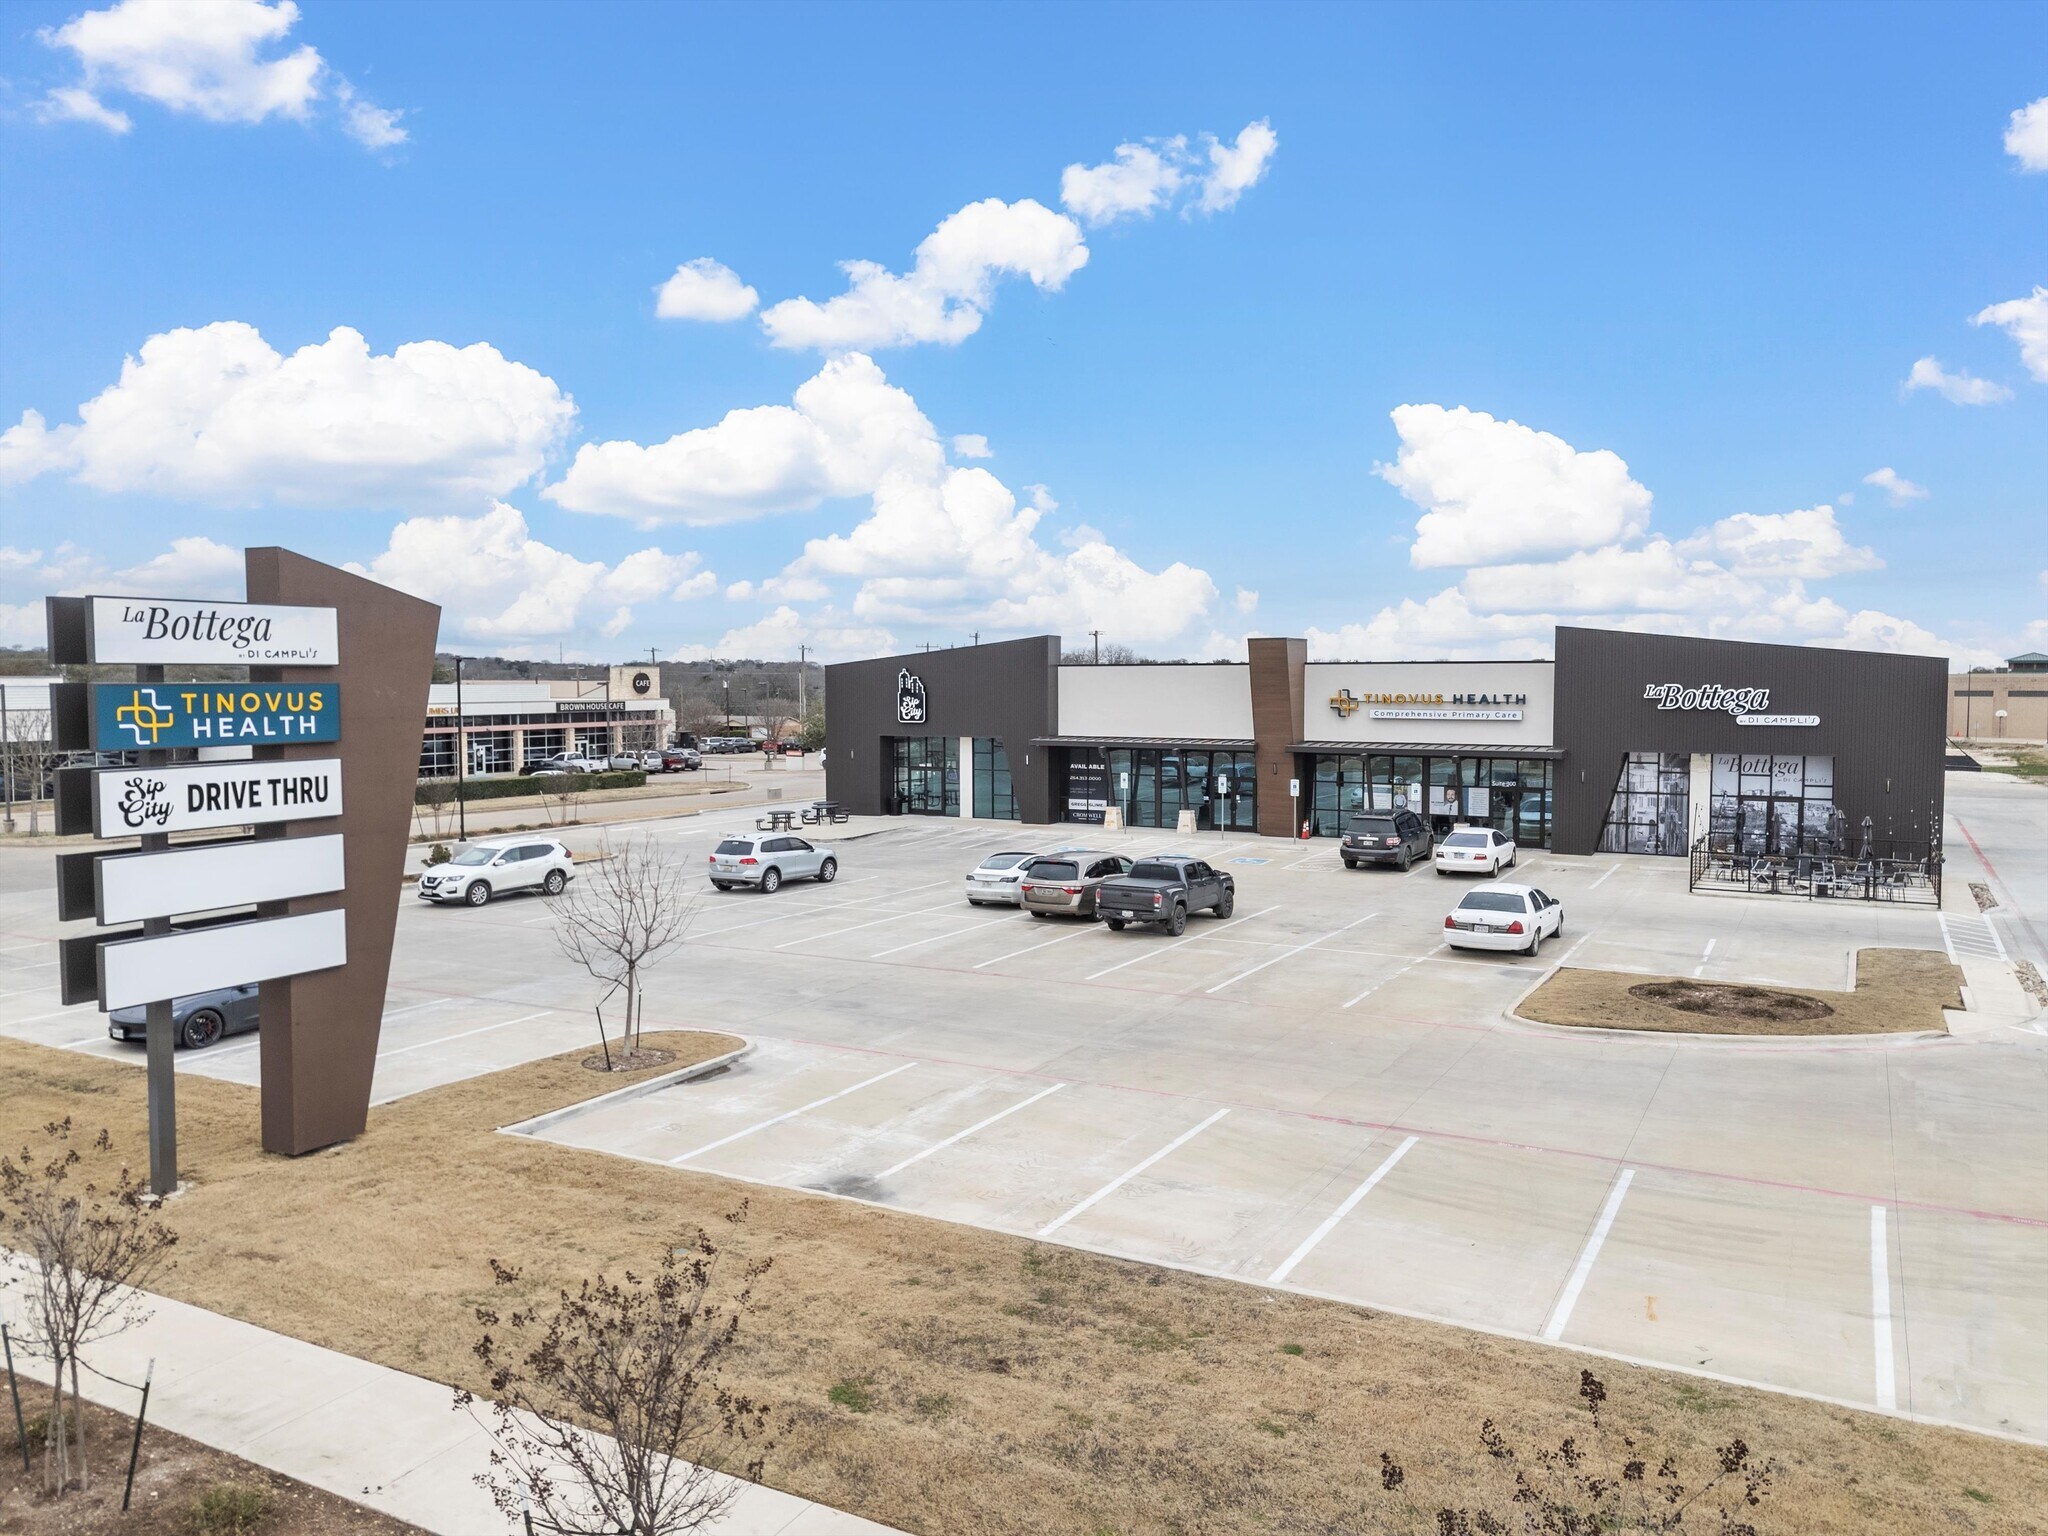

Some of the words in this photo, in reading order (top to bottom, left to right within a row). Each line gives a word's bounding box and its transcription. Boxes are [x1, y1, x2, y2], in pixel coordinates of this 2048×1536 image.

[122, 606, 145, 623] La
[142, 607, 272, 649] Bottega
[248, 650, 259, 658] DI
[265, 648, 318, 659] CAMPLI'S
[181, 692, 324, 714] TINOVUS
[560, 703, 585, 711] BROWN
[586, 702, 607, 711] HOUSE
[608, 702, 624, 710] CAFE
[902, 696, 920, 708] Sip
[1364, 693, 1445, 705] TINOVUS
[1452, 693, 1527, 705] HEALTH
[1644, 684, 1664, 699] La
[1658, 684, 1769, 715] Bottega
[900, 705, 923, 720] City
[1373, 710, 1448, 719] Comprehensive
[1452, 711, 1491, 720] Primary
[193, 715, 316, 739] HEALTH
[1728, 757, 1799, 777] Bottega
[124, 777, 167, 801] Sip
[187, 780, 262, 813] DRIVE
[267, 775, 329, 806] THRU
[118, 799, 174, 828] City
